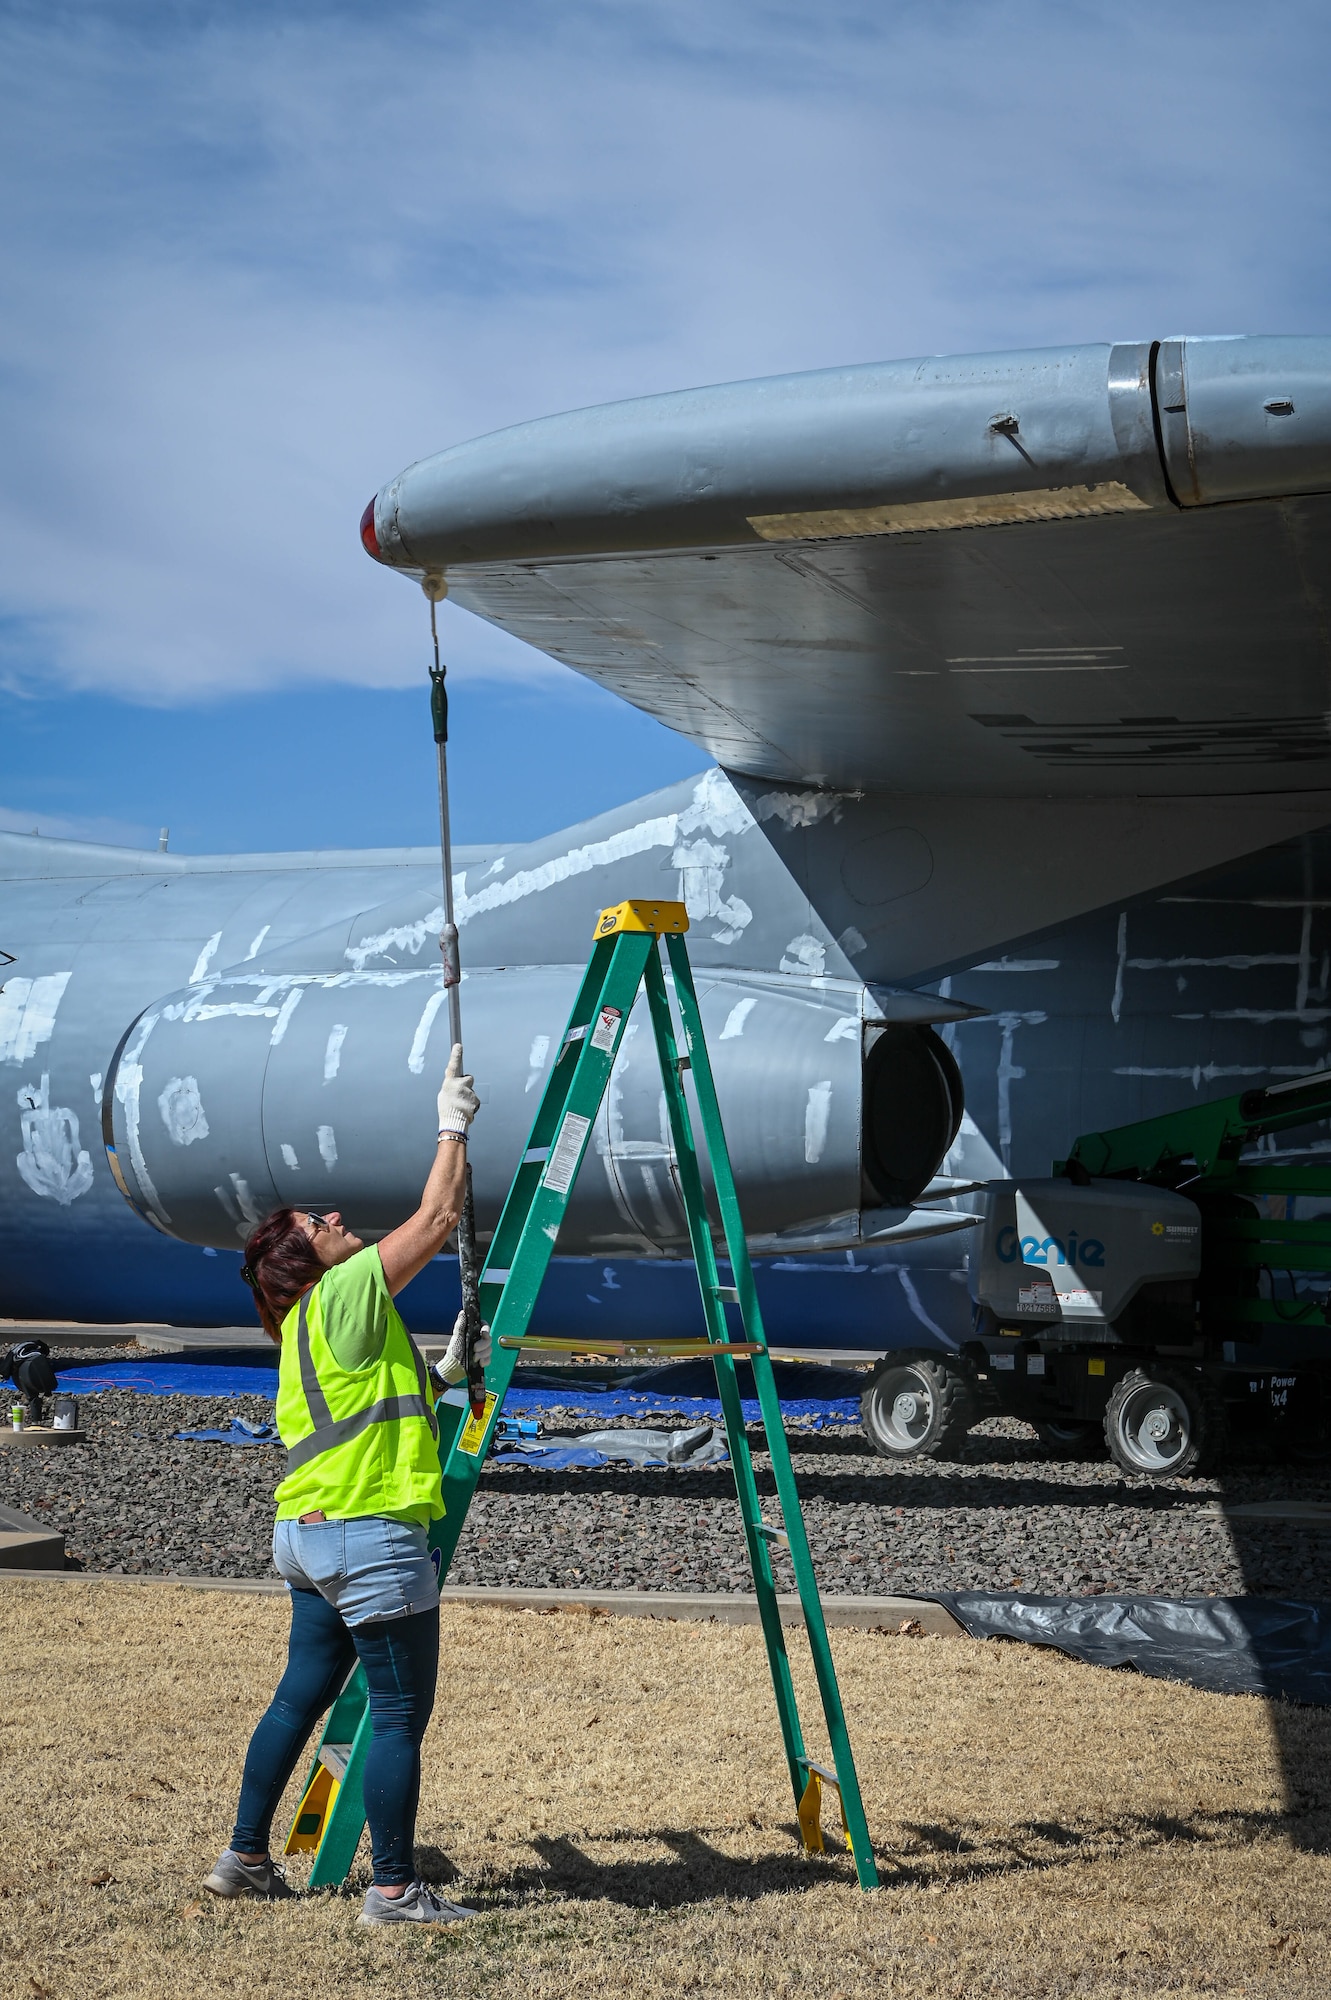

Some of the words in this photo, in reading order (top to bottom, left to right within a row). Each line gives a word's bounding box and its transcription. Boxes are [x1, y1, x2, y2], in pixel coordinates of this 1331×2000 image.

[1165, 1225, 1199, 1234] SUNBELT
[995, 1225, 1105, 1267] Genie
[1271, 1376, 1297, 1388] Power
